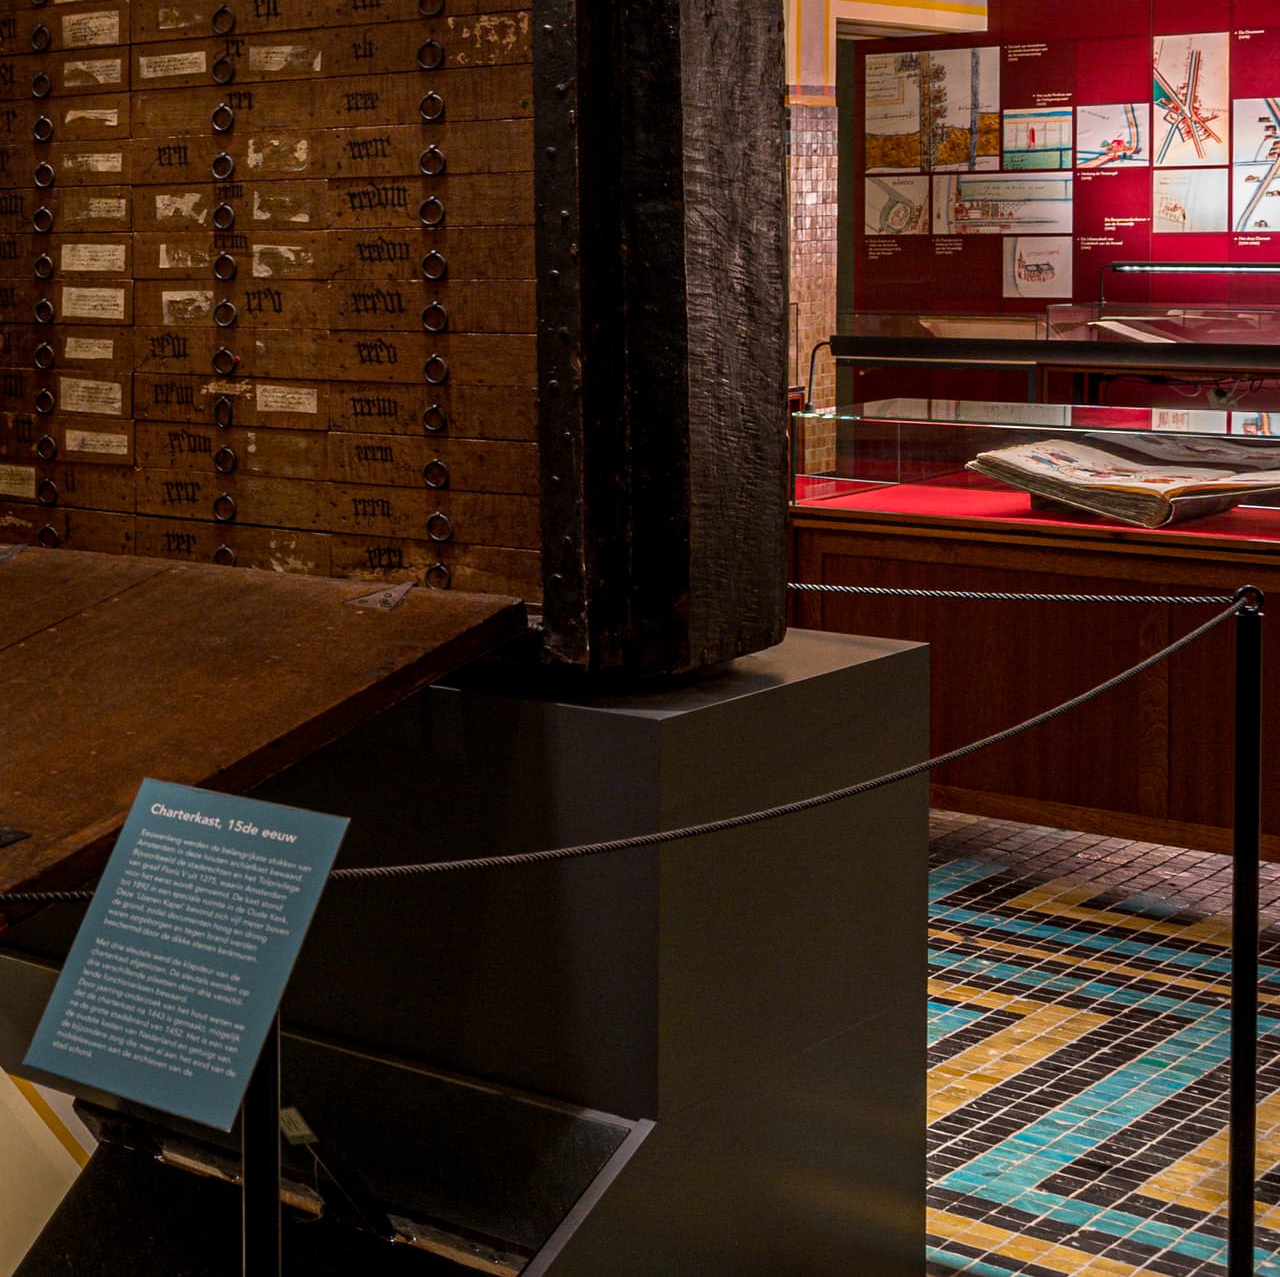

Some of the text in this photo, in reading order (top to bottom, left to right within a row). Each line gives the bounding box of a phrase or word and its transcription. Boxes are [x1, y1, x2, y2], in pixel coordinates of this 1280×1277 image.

[150, 803, 298, 843] Charterkast, 15de eeuw
